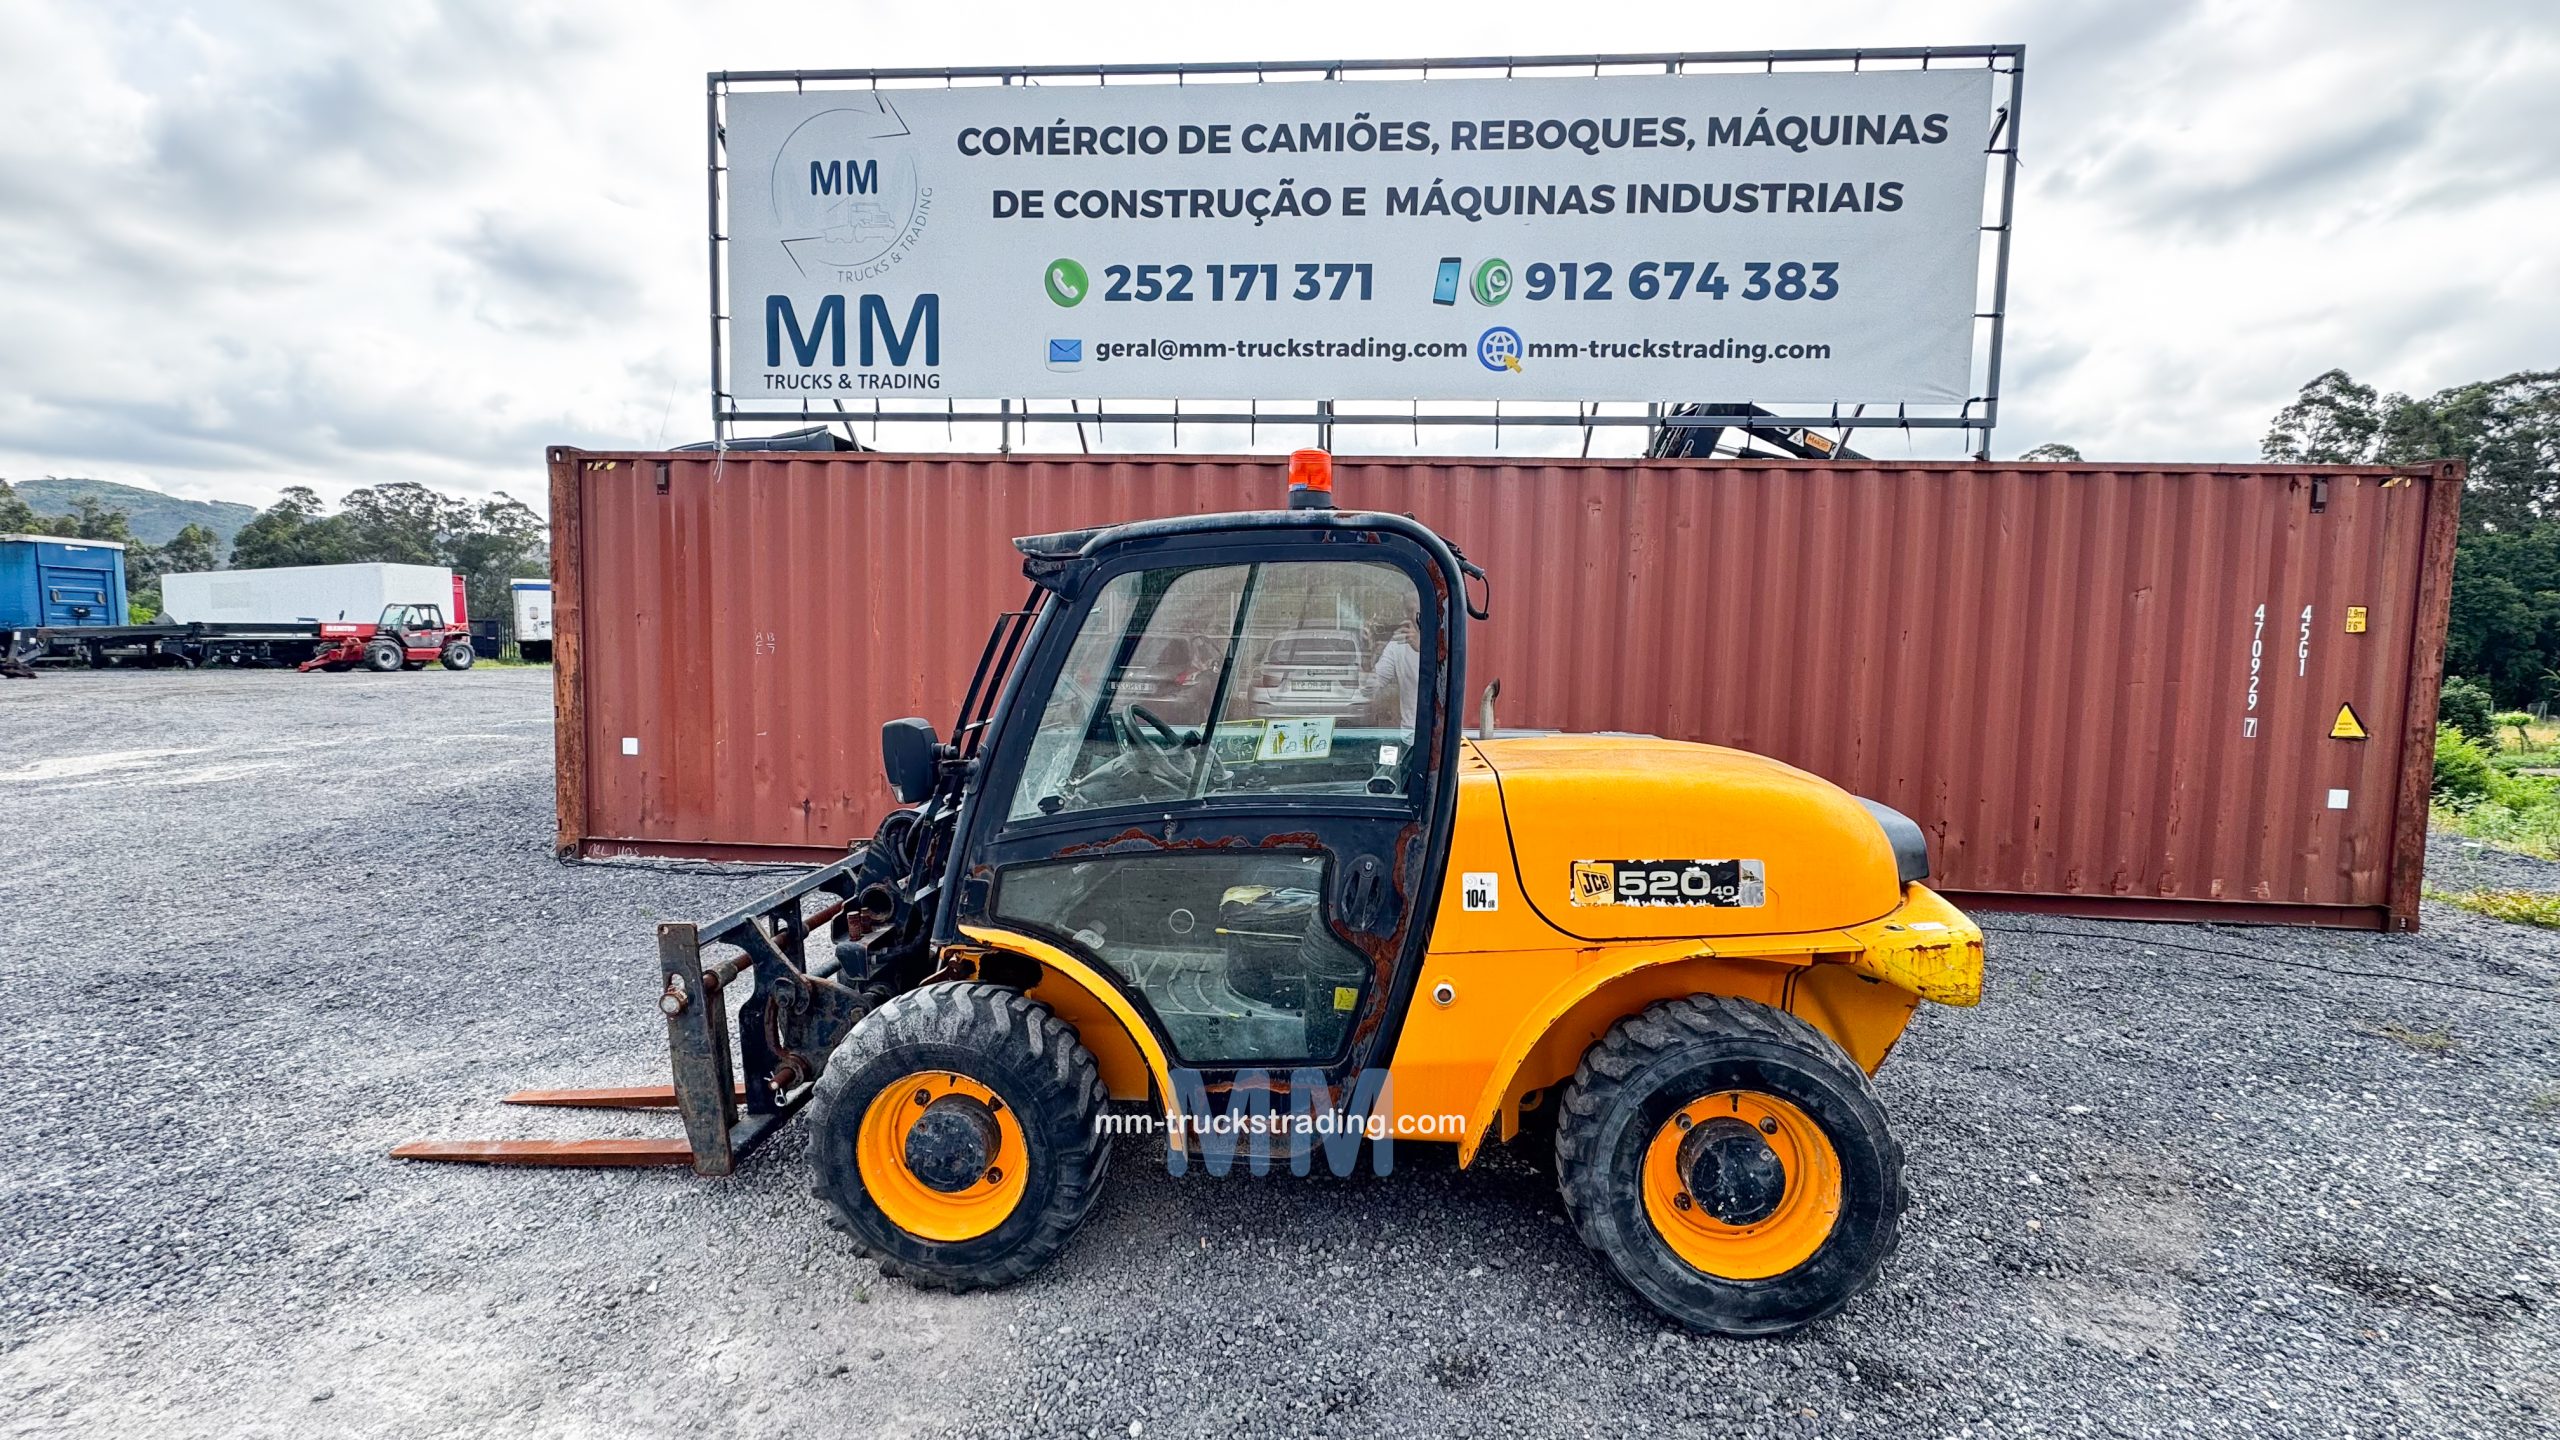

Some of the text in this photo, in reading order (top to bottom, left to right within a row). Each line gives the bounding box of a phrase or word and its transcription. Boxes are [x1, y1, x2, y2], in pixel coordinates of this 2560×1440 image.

[956, 106, 1949, 157] COMÉRCIO DE CAMIÕES, REBOQUES, MÁQUINAS
[810, 159, 878, 195] MM
[992, 177, 1905, 226] DE CONSTRUÇÃO E MÁQUINAS INDUSTRIAIS
[837, 186, 934, 283] TRUCKS & TRADING
[1103, 263, 1373, 302] 252 171 371
[1525, 261, 1840, 301] 912 674 383
[765, 293, 940, 368] MM
[1096, 338, 1468, 363] geral@mm-truckstrading.com
[1528, 338, 1831, 364] mm-truckstrading.com
[763, 373, 941, 390] TRUCKS & TRADING
[2298, 604, 2313, 677] 45G1
[2245, 603, 2266, 738] 470929 7
[1465, 889, 1487, 908] 104
[1581, 870, 1735, 896] JCB 520 40
